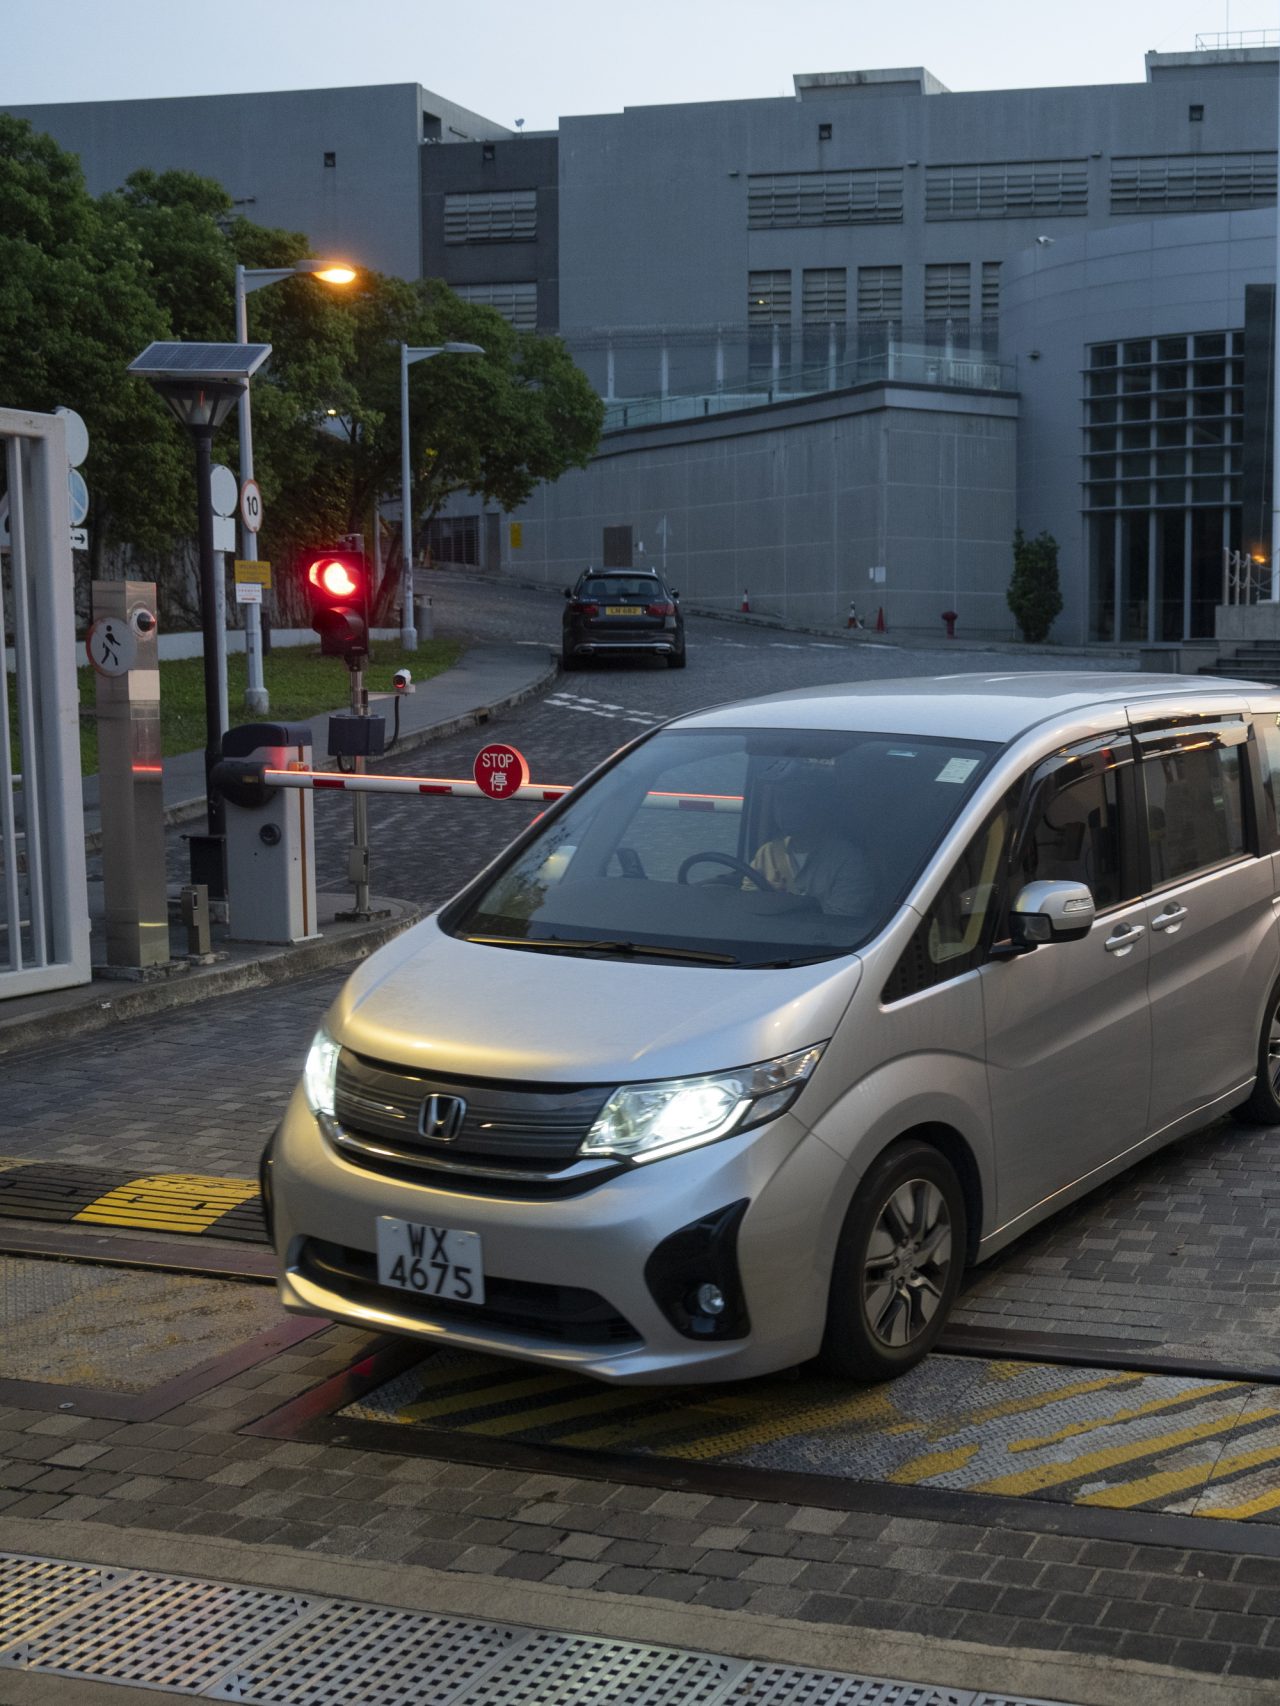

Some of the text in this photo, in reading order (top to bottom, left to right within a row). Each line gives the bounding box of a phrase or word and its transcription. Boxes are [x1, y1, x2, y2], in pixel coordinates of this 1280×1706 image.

[246, 495, 259, 516] 10
[482, 753, 514, 769] STOP
[489, 771, 508, 792] 停
[407, 1223, 449, 1263] WX
[389, 1255, 473, 1300] 4675
